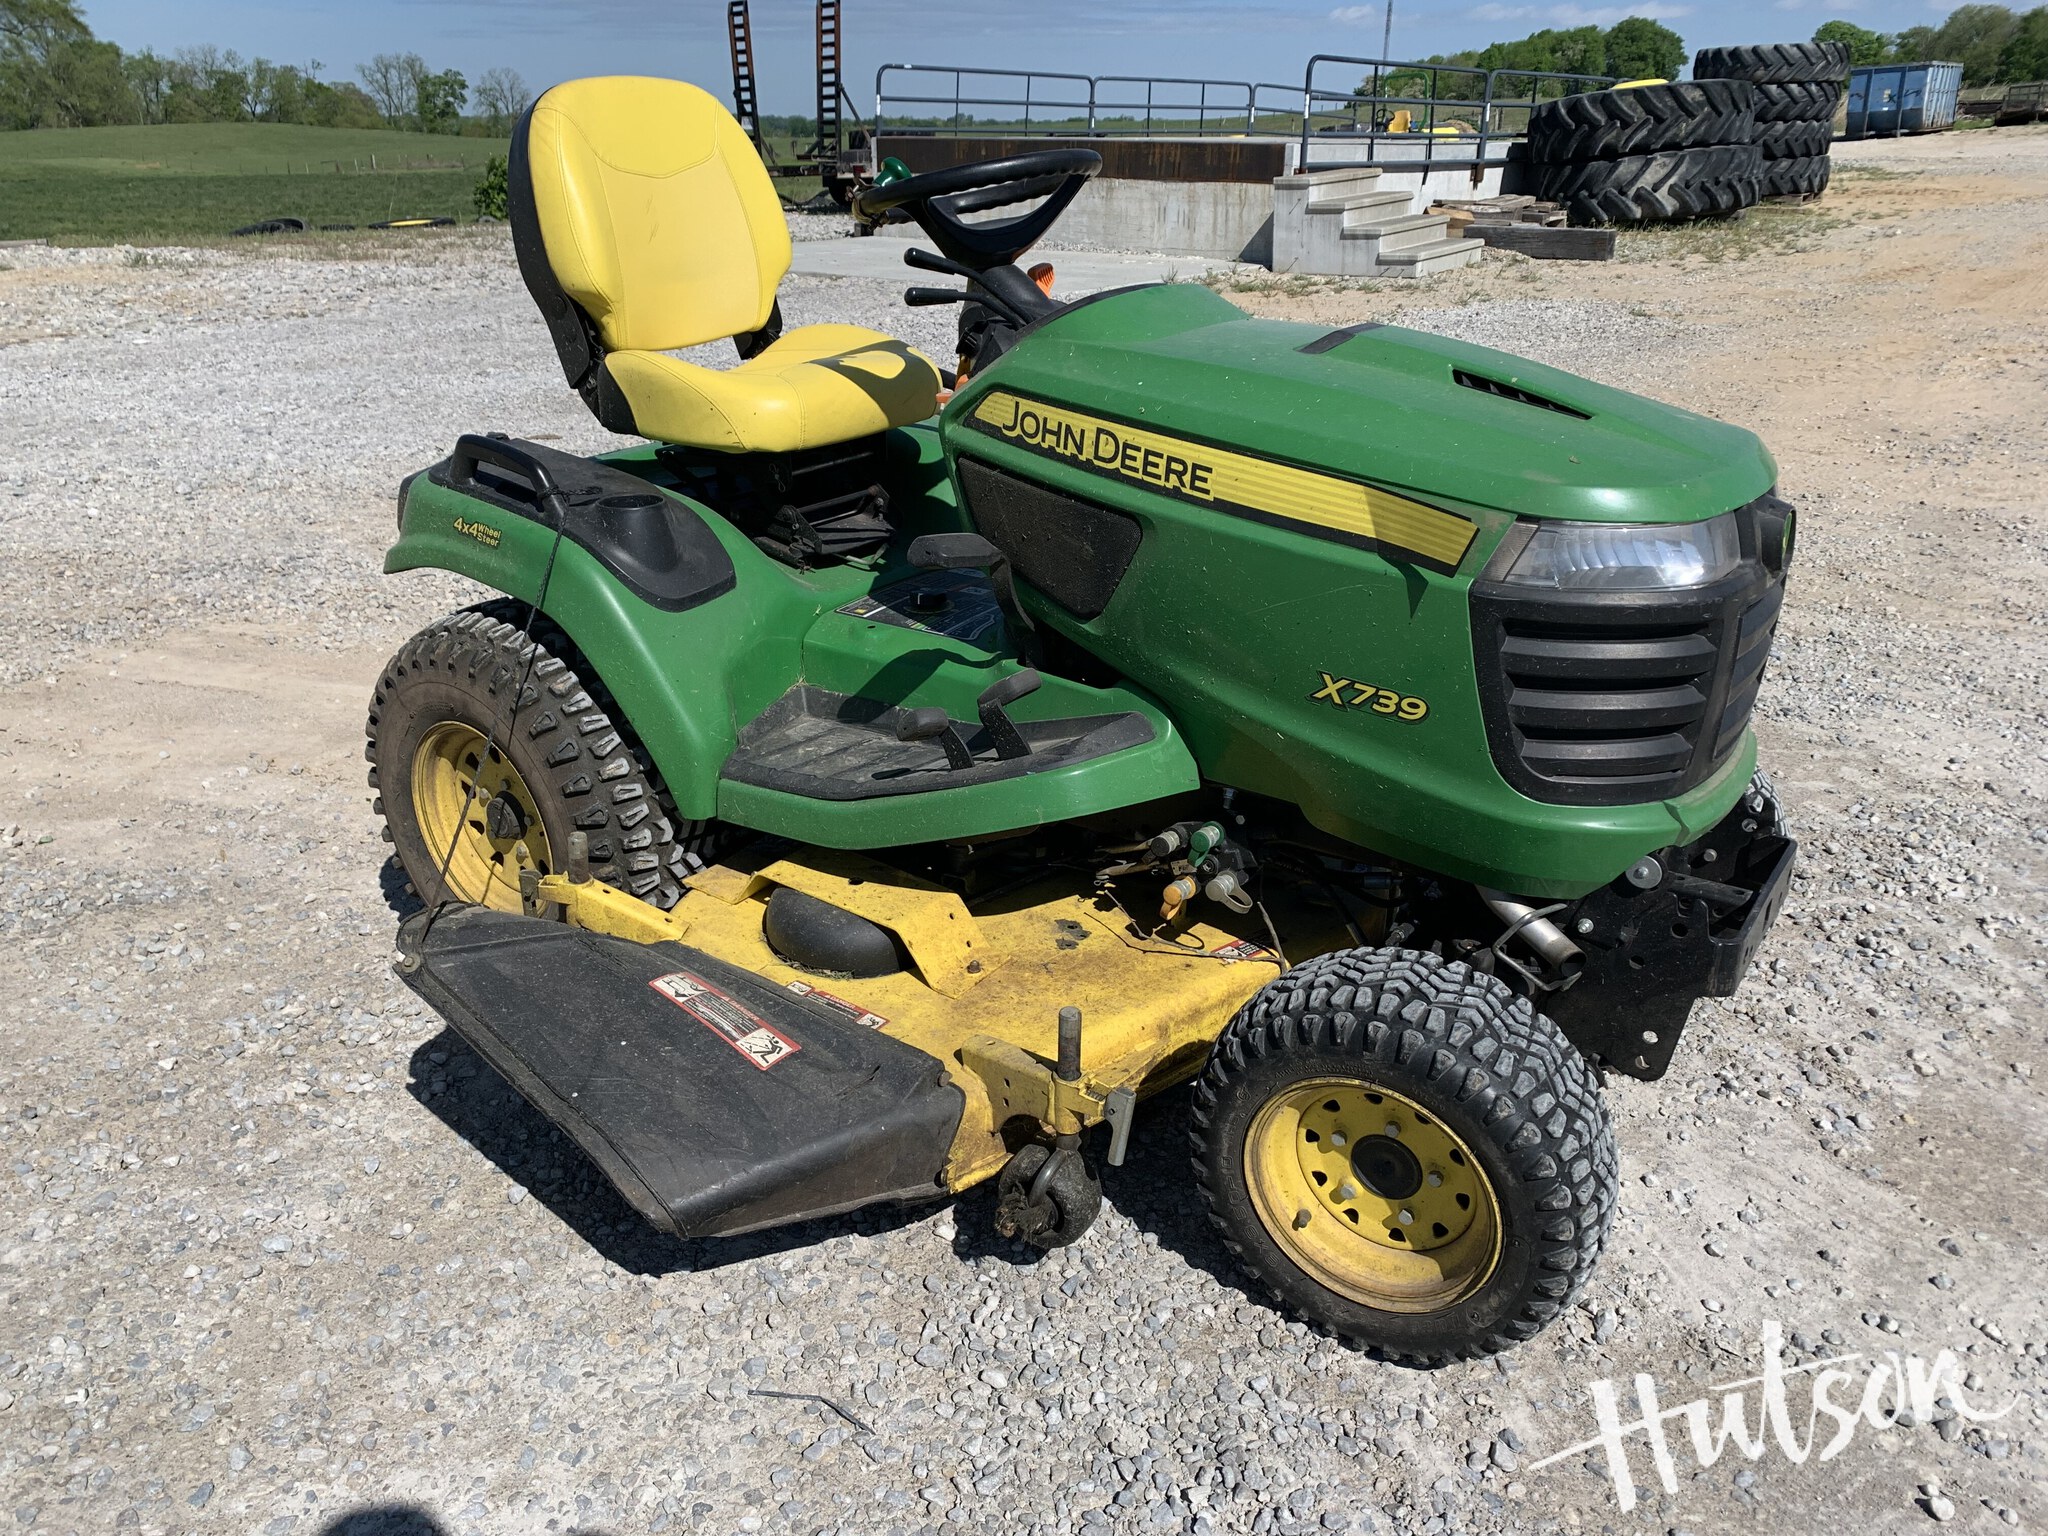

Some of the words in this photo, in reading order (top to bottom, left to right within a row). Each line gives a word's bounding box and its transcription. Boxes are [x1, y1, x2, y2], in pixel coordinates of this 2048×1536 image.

[1002, 401, 1086, 456] JOHN
[1093, 426, 1213, 496] DEERE
[453, 517, 478, 537] 4x4
[478, 522, 502, 539] Wheel
[476, 532, 500, 547] Steer
[1309, 671, 1429, 721] X739
